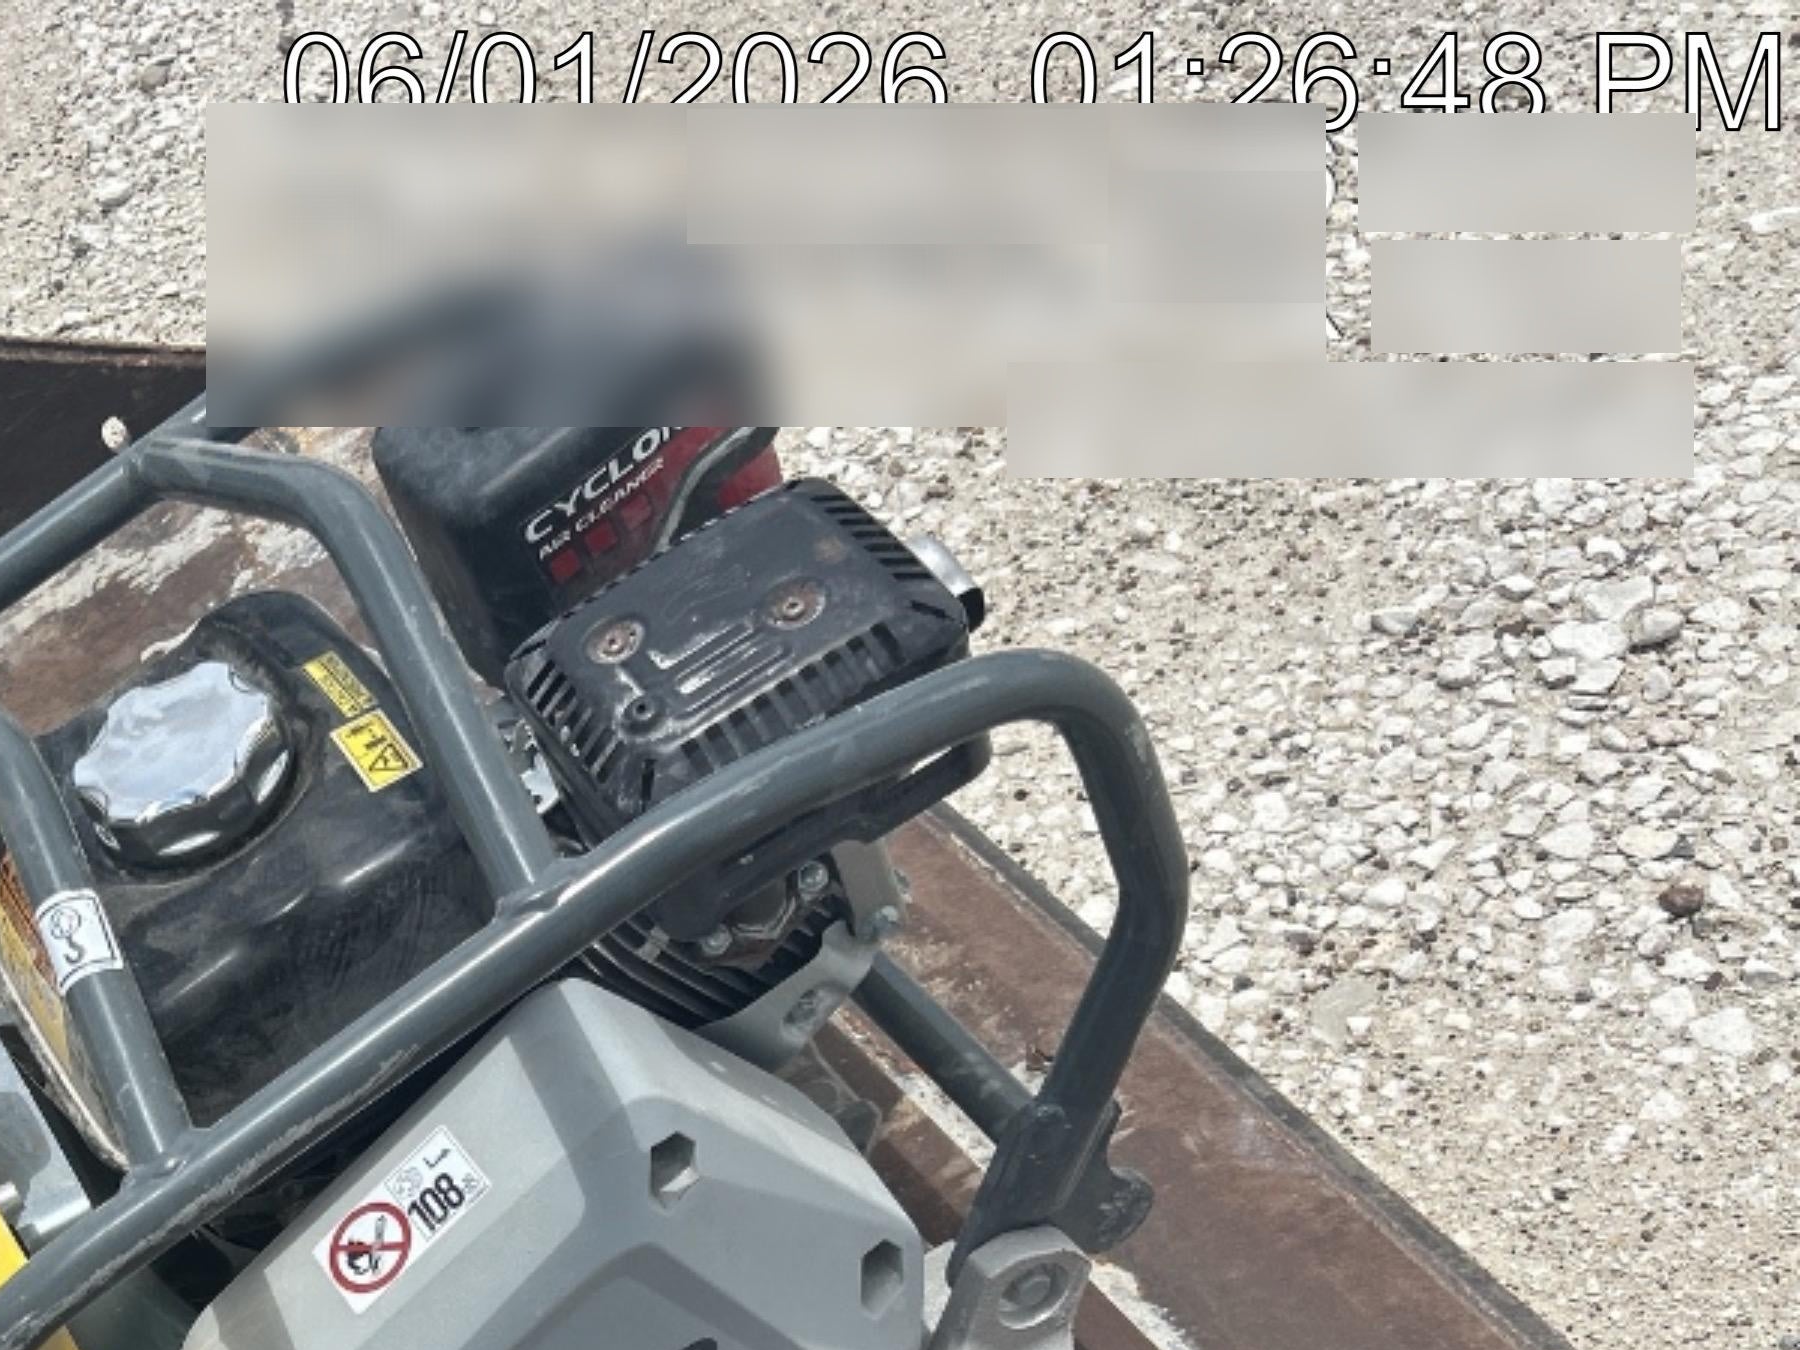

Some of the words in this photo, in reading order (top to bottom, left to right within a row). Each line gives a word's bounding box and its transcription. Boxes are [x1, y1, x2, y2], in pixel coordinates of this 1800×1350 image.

[539, 529, 571, 560] AIR
[575, 456, 665, 533] CLEANER
[407, 1172, 465, 1232] 108
